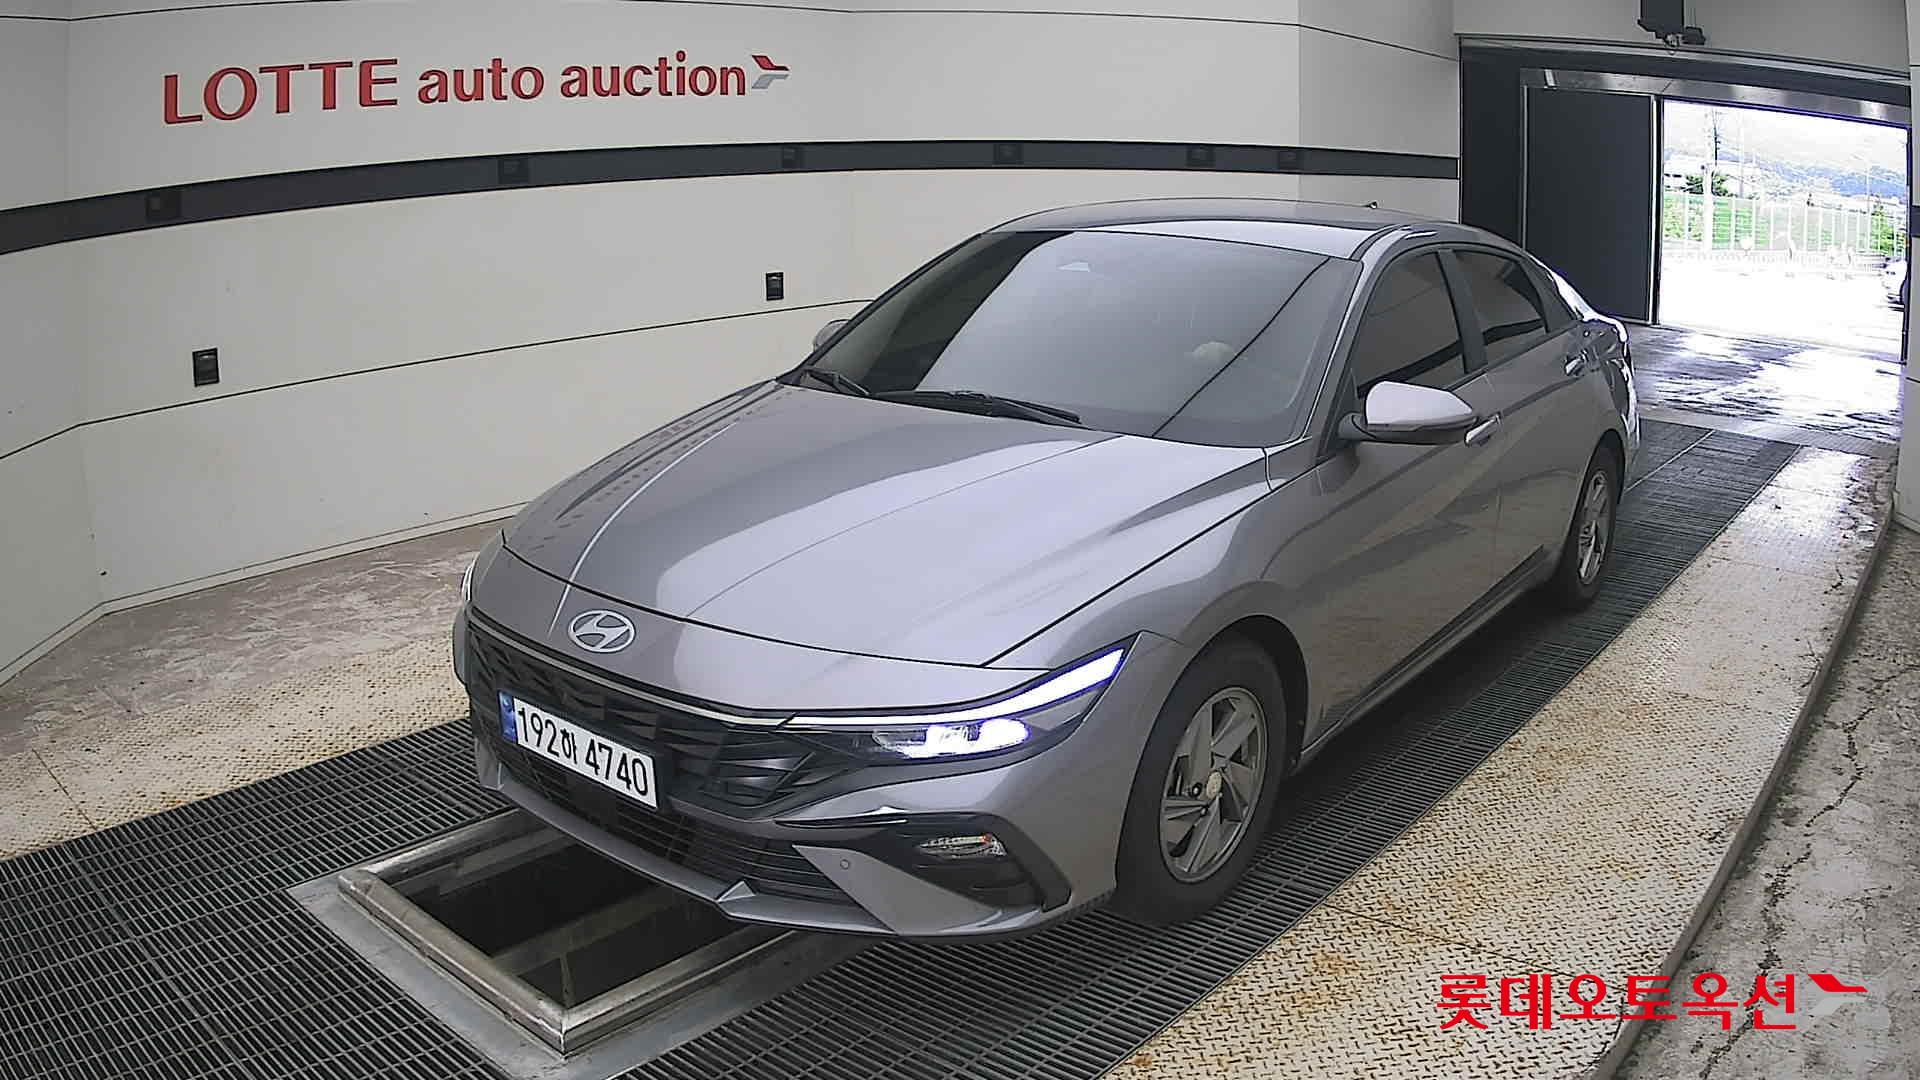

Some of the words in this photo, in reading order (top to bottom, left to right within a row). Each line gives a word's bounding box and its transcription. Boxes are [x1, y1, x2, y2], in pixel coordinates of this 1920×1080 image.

[163, 58, 398, 125] LOTTE
[417, 57, 545, 104] auto
[560, 50, 746, 97] auction
[518, 707, 578, 765] 192하
[585, 738, 649, 796] 4740
